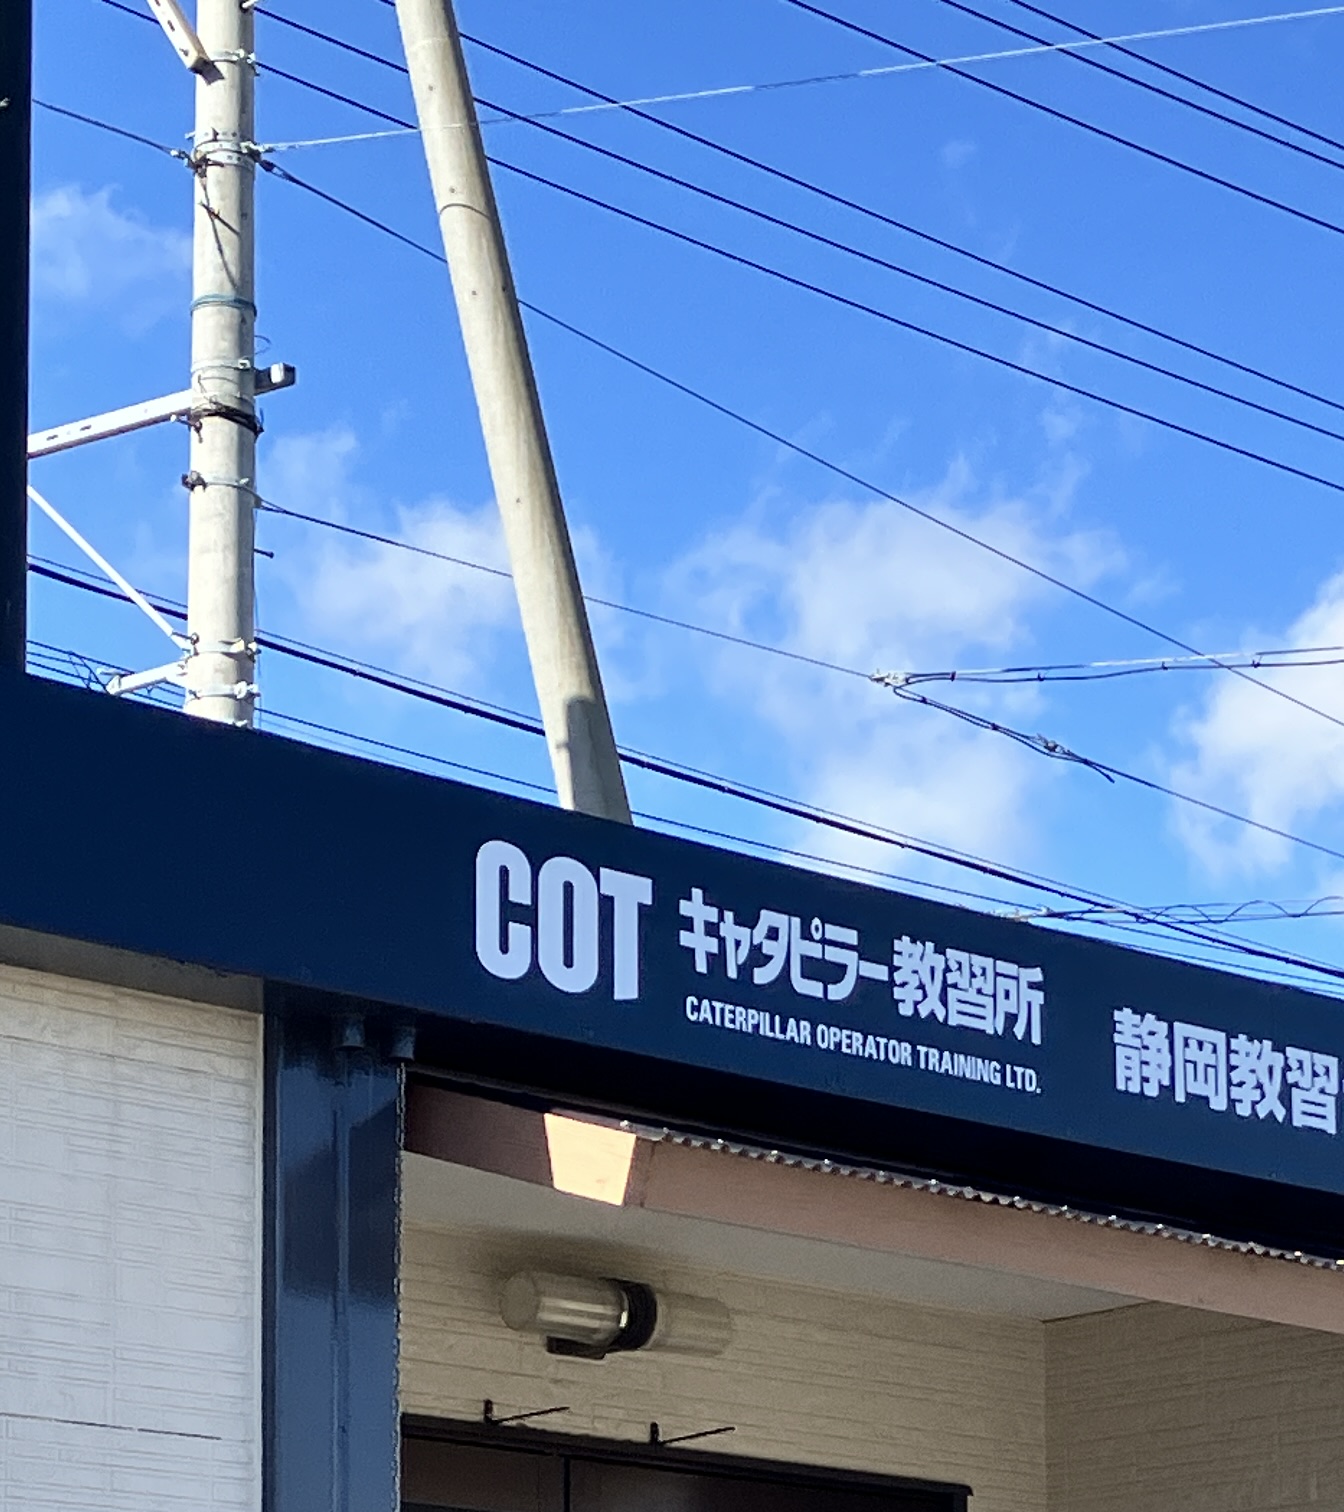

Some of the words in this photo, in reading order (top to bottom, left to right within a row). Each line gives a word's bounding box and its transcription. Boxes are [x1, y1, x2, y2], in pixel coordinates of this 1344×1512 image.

[475, 839, 653, 1001] COT
[678, 886, 1045, 1045] キャタピラー教習所
[686, 995, 812, 1047] CATERPILLAR
[816, 1023, 913, 1068] OPERATOR
[917, 1044, 1002, 1086] TRAINING
[1005, 1064, 1043, 1094] LTD.
